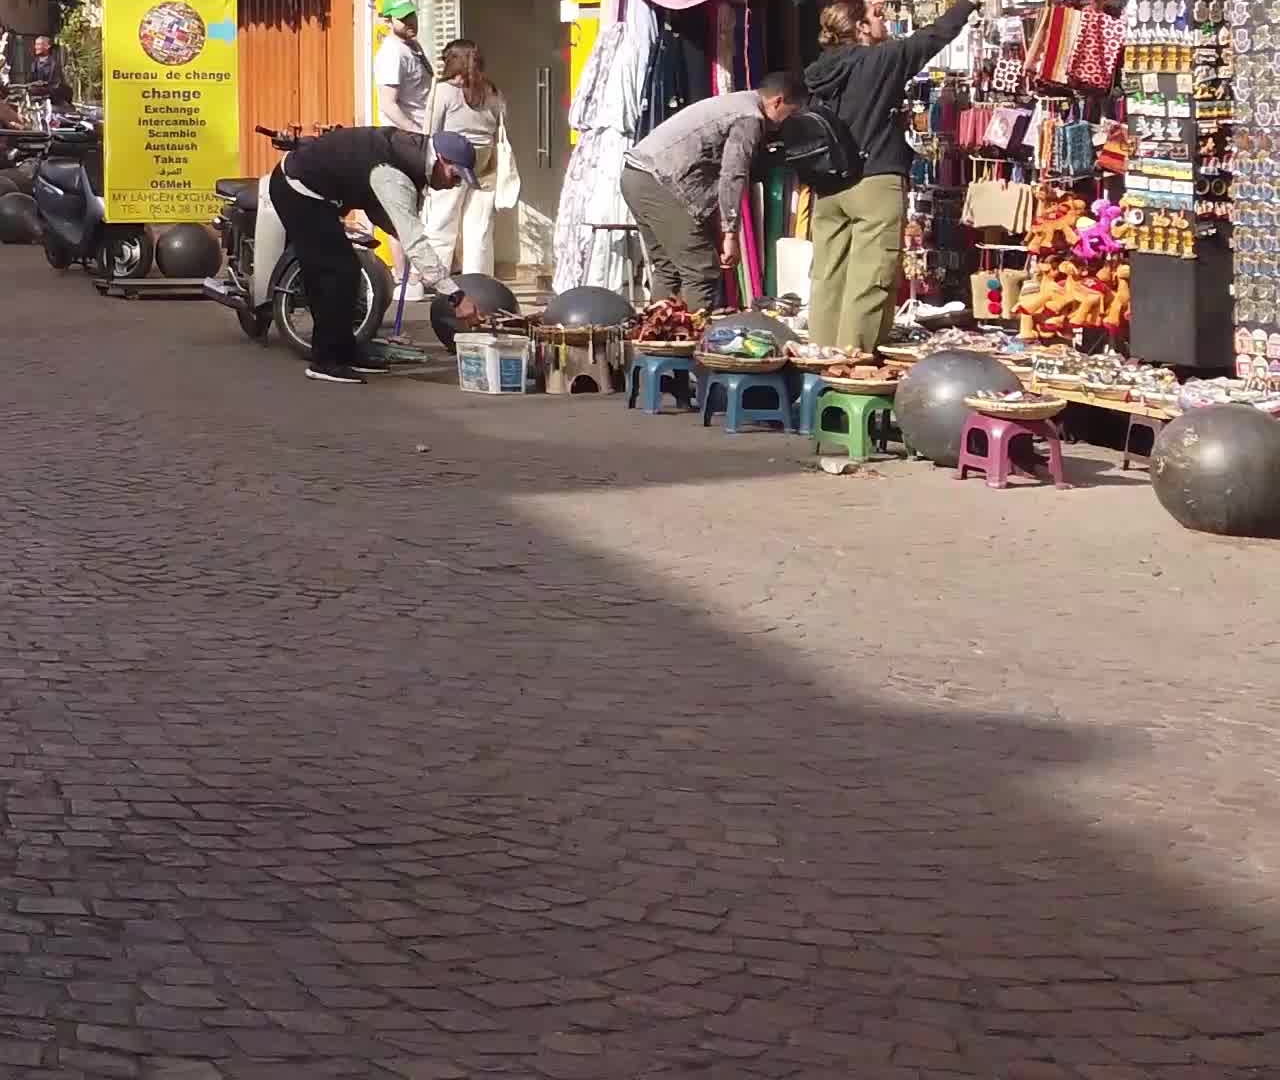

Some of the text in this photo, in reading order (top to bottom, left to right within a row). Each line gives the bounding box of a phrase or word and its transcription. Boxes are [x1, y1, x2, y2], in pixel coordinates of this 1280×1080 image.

[112, 69, 232, 82] Bureau de change
[141, 88, 201, 102] change
[144, 105, 200, 116] Exchange
[138, 117, 207, 127] Intercambio
[148, 129, 197, 138] Scambio
[144, 142, 198, 151] Austaush
[153, 155, 188, 165] Takas
